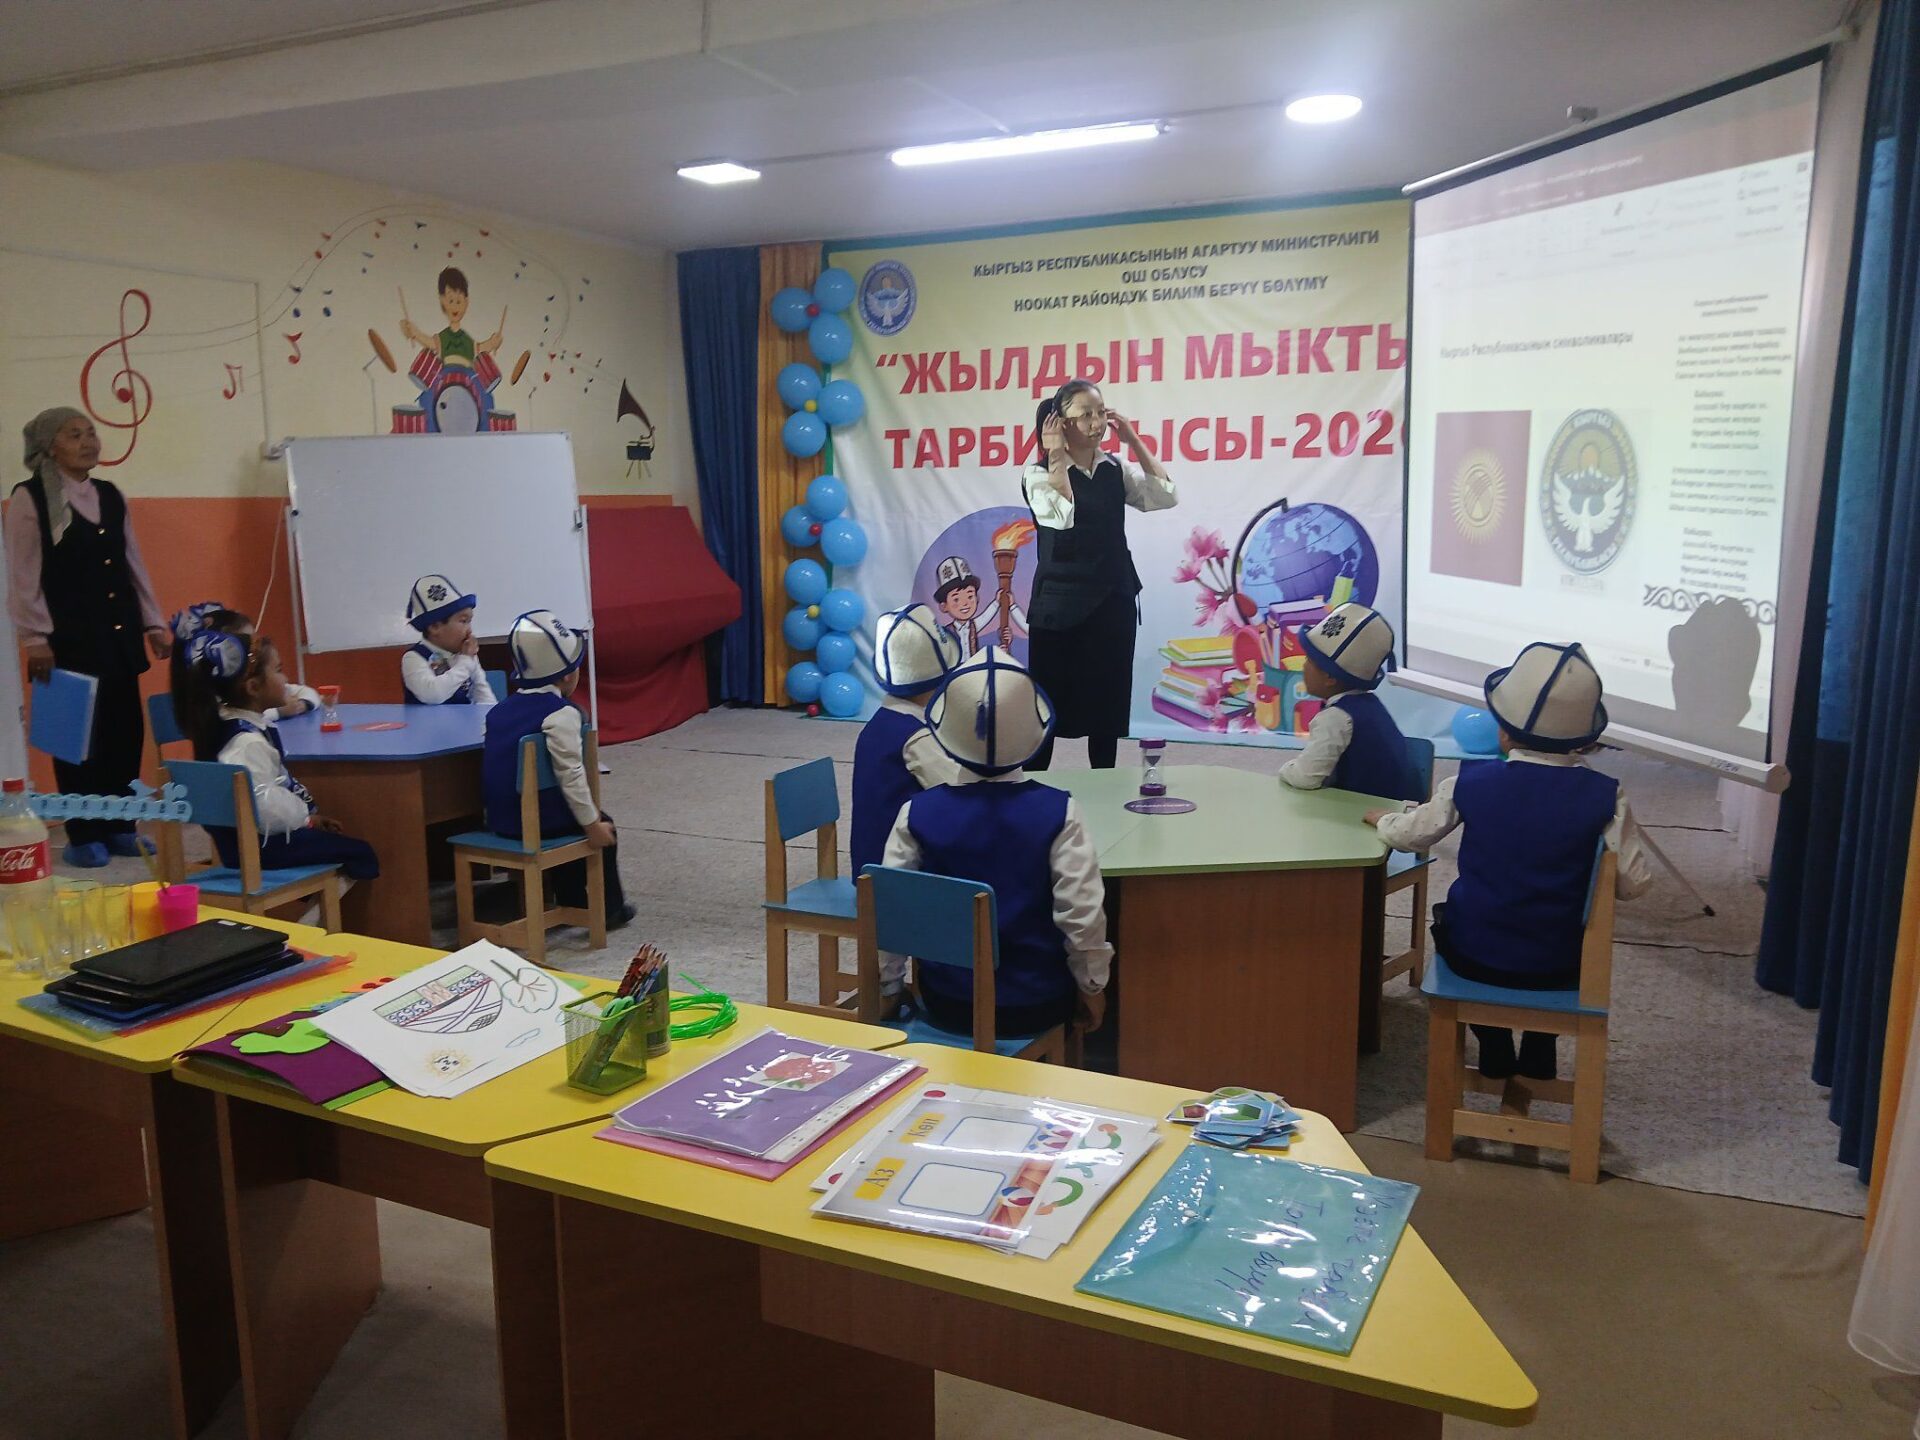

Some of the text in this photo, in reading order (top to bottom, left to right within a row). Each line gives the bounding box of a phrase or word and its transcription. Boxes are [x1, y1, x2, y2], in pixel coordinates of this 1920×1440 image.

[973, 230, 1380, 277] КЫРГЫЗ РЕСПУБЛИКАСЫНЫН АГАРТУУ МИНИСТРЛИГИ
[1121, 265, 1208, 284] ОШ ОБЛУСУ
[1014, 276, 1329, 312] НООКАТ РАЙОНДУК БИЛИМ БЕРҮҮ БӨЛҮМҮ
